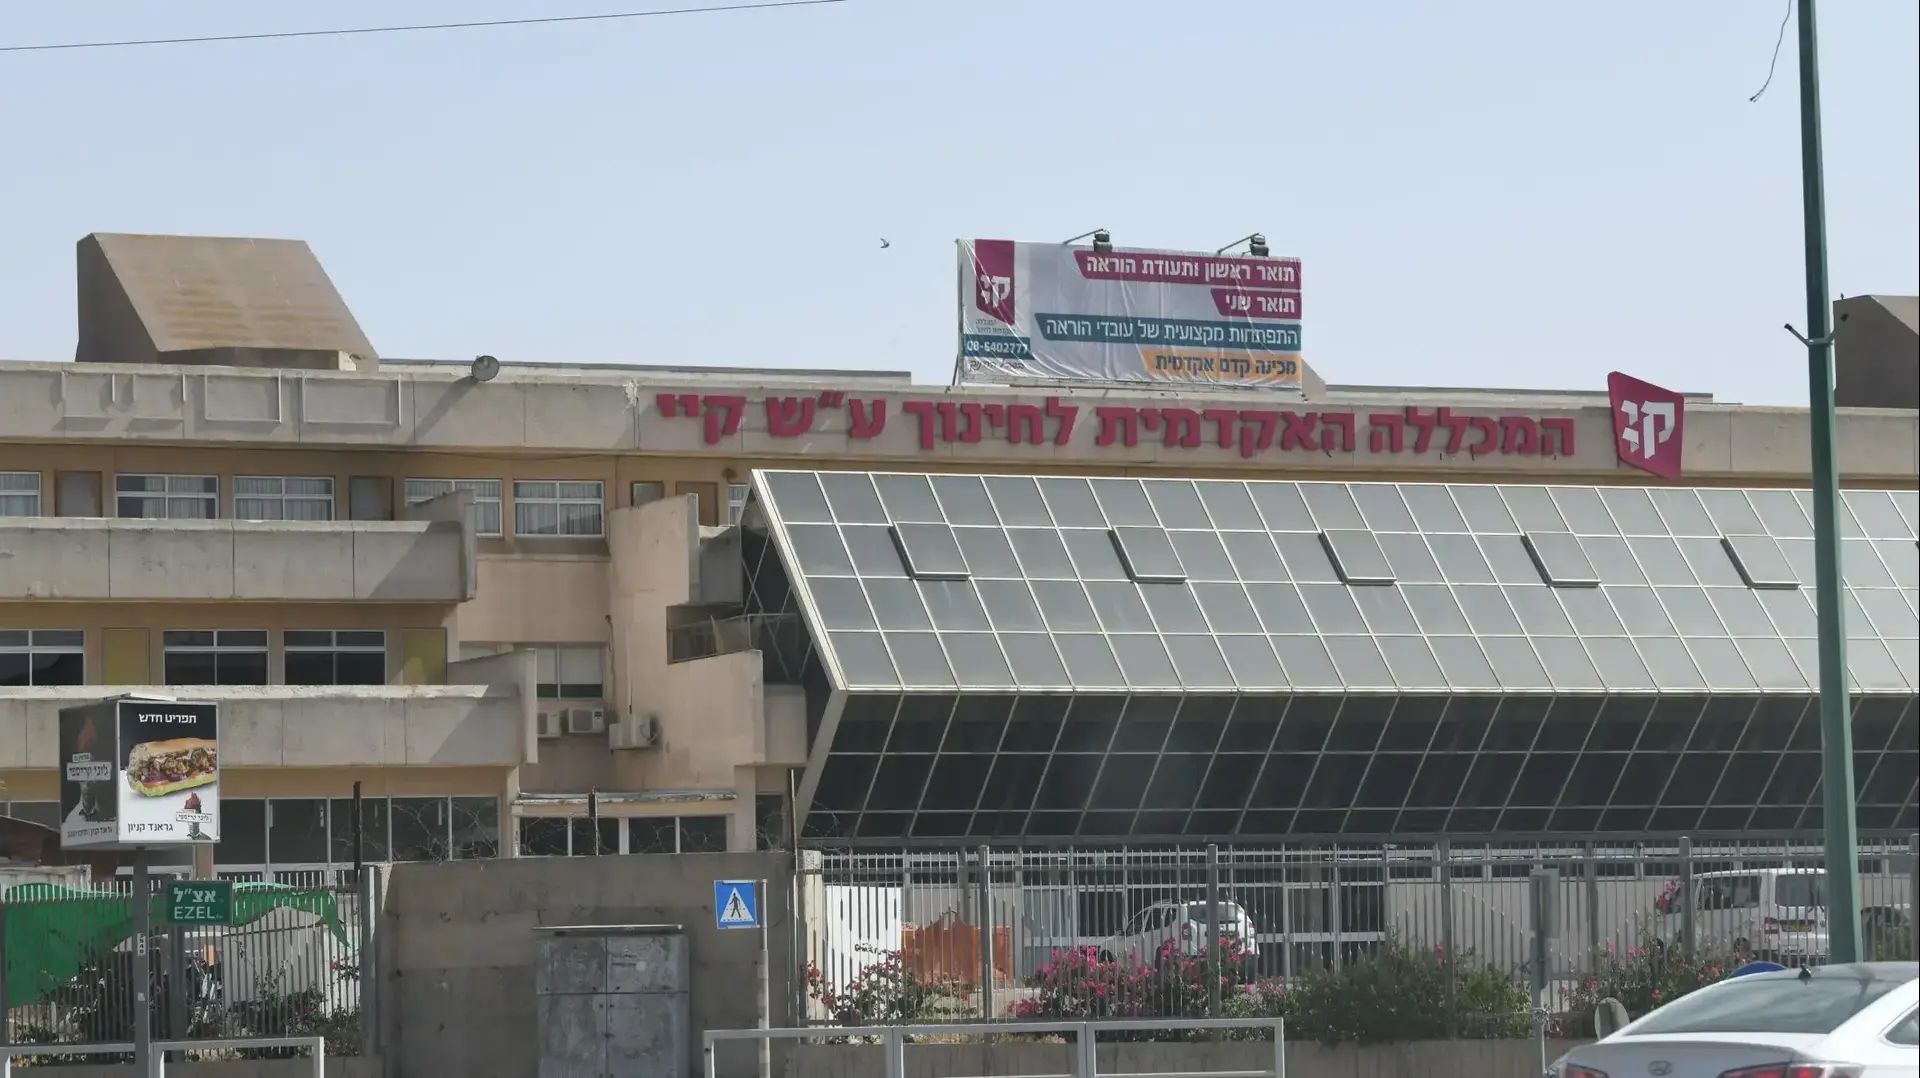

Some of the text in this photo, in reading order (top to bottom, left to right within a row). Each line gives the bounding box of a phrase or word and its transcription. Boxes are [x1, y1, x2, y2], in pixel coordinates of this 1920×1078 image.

[1086, 255, 1295, 283] תואר ראשון ותעודת הוראה
[1225, 295, 1296, 313] תואר שני
[1046, 319, 1298, 346] התפתחות מקצועית של עובדי הוראה
[966, 340, 1029, 354] 08-6402777
[1155, 354, 1297, 377] מכינה קדם אקדמית
[655, 390, 1576, 458] המכללה האקדמית לחינוך ע"ש קיי
[138, 713, 197, 724] תפריט חדש
[128, 822, 174, 833] גראנד קניון
[173, 887, 217, 903] אצ"ל
[174, 906, 215, 919] EZEL
